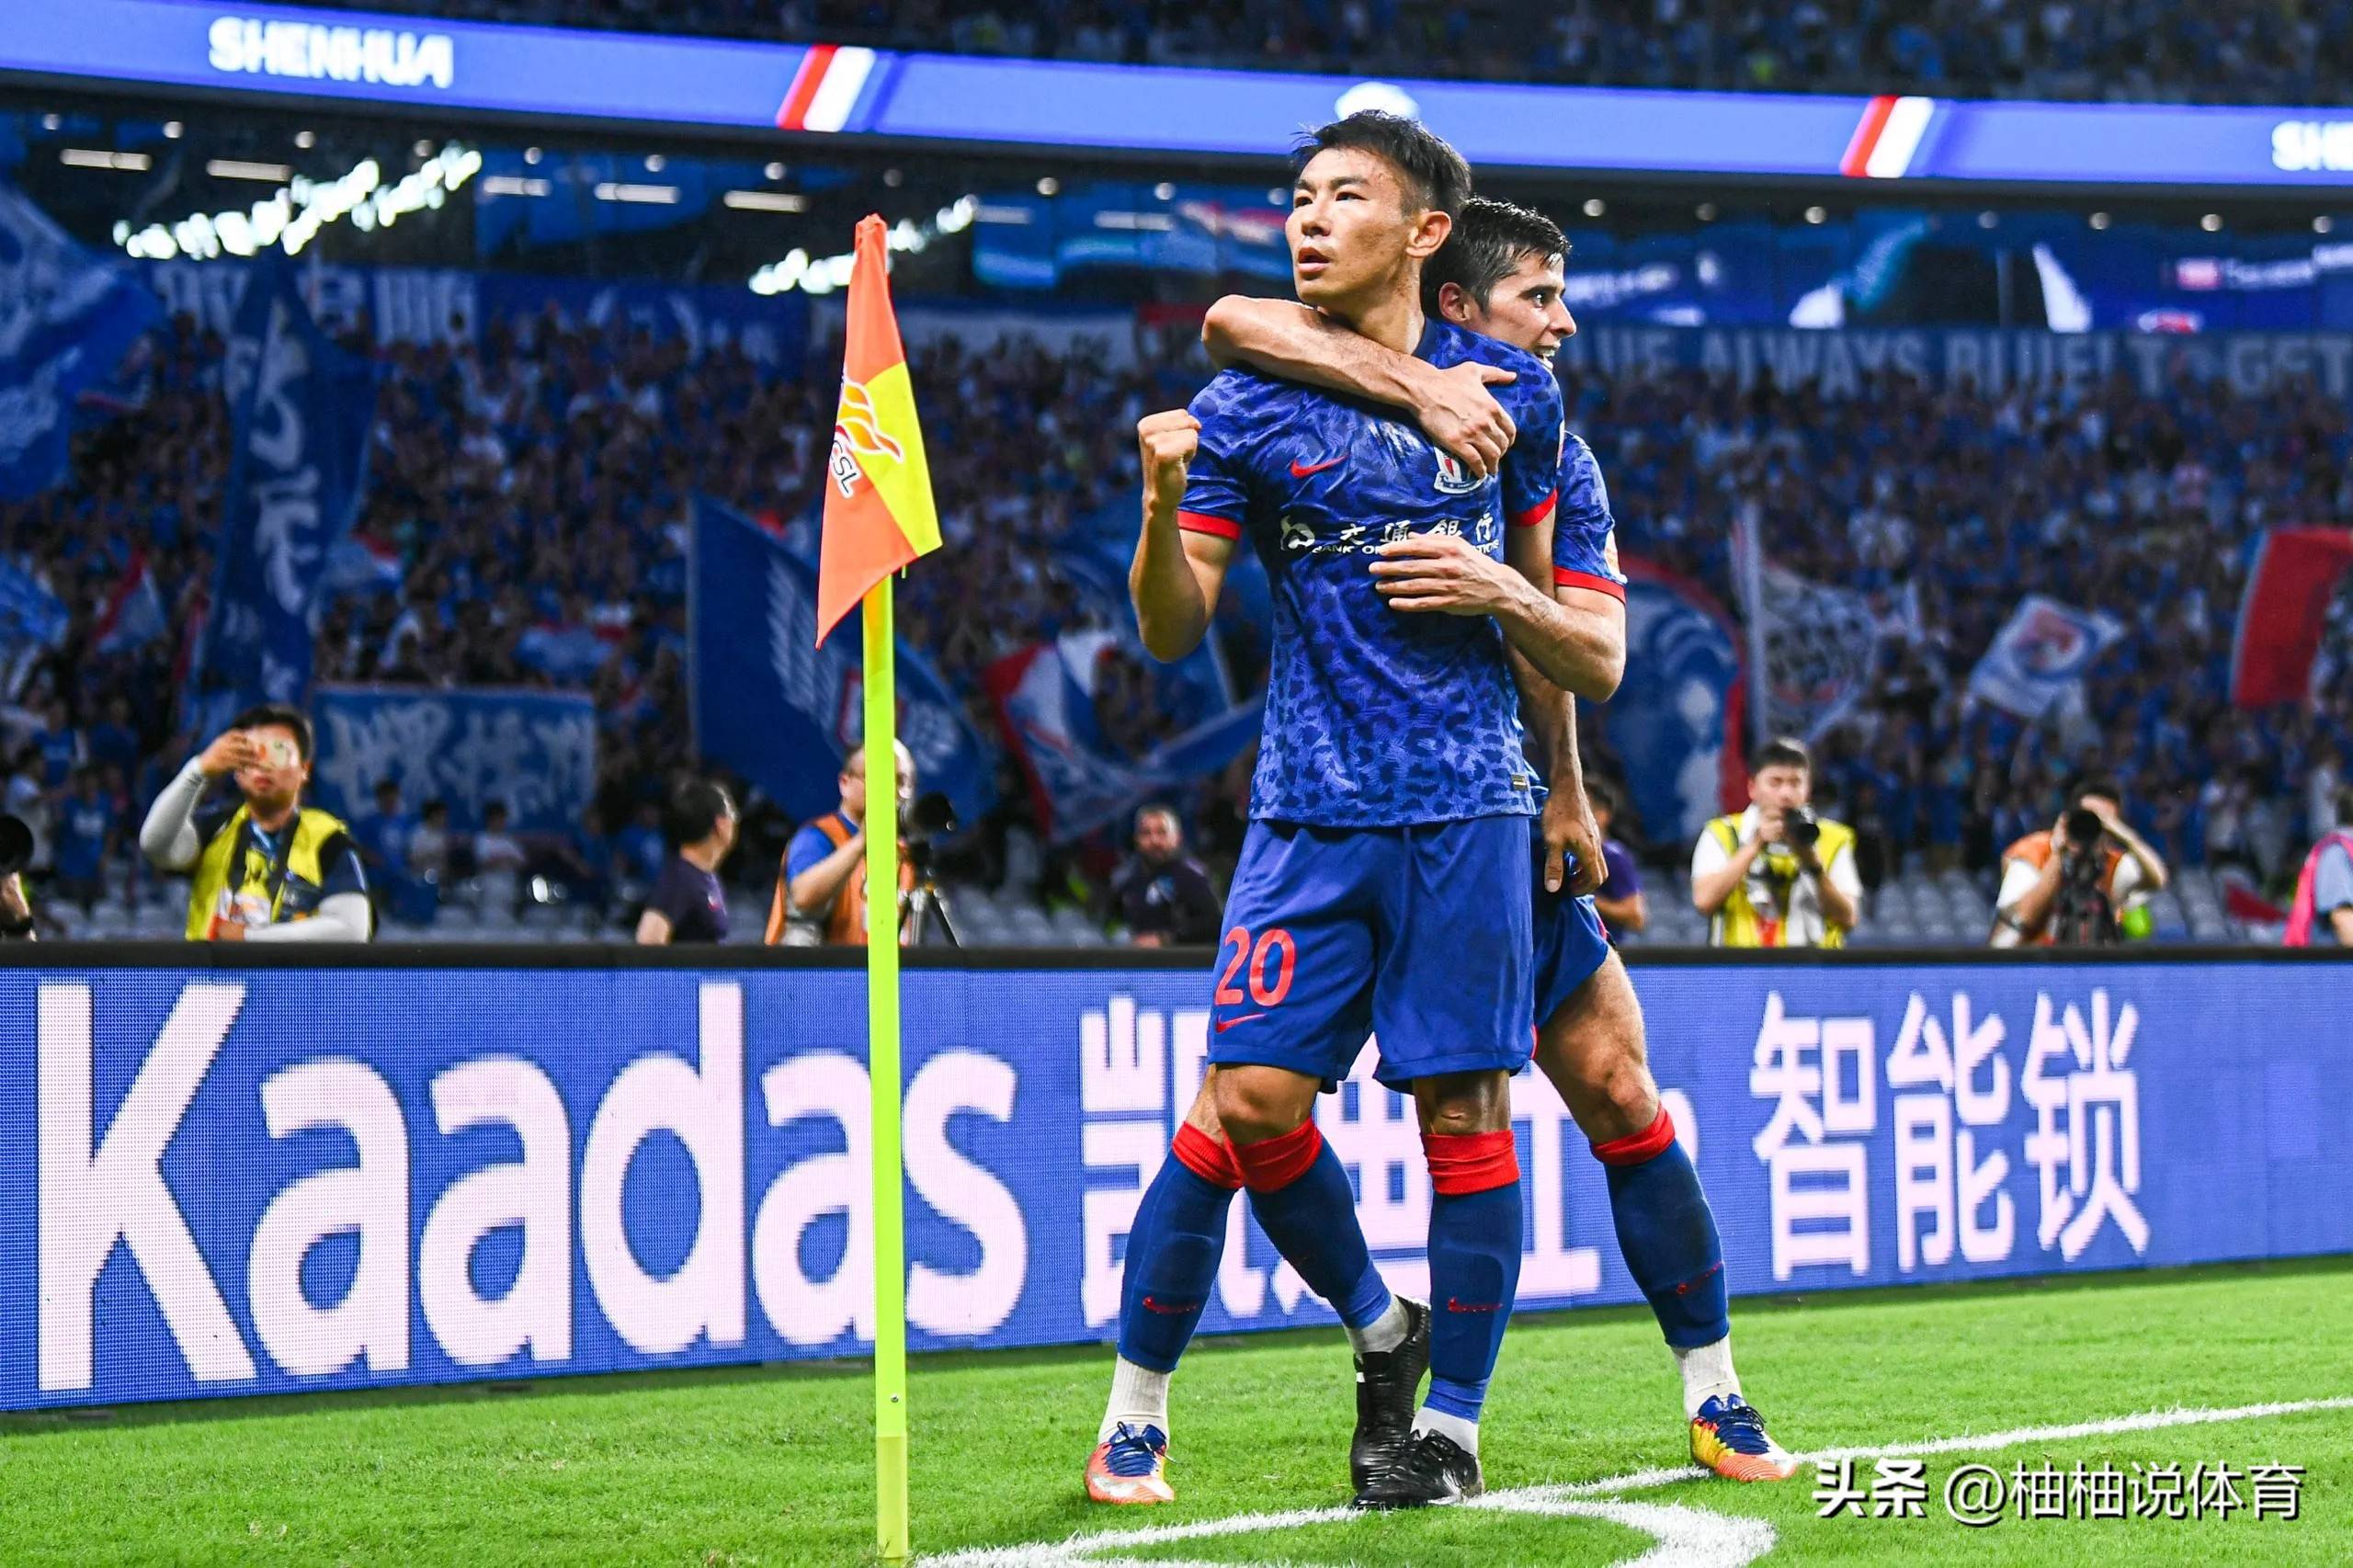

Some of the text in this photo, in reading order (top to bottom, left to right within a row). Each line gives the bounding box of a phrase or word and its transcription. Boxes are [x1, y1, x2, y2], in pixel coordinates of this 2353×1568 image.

[209, 16, 453, 88] SHENHUA
[1214, 926, 1297, 1006] 20
[38, 983, 1028, 1391] Kaadas
[1750, 988, 2152, 1281] 智能锁
